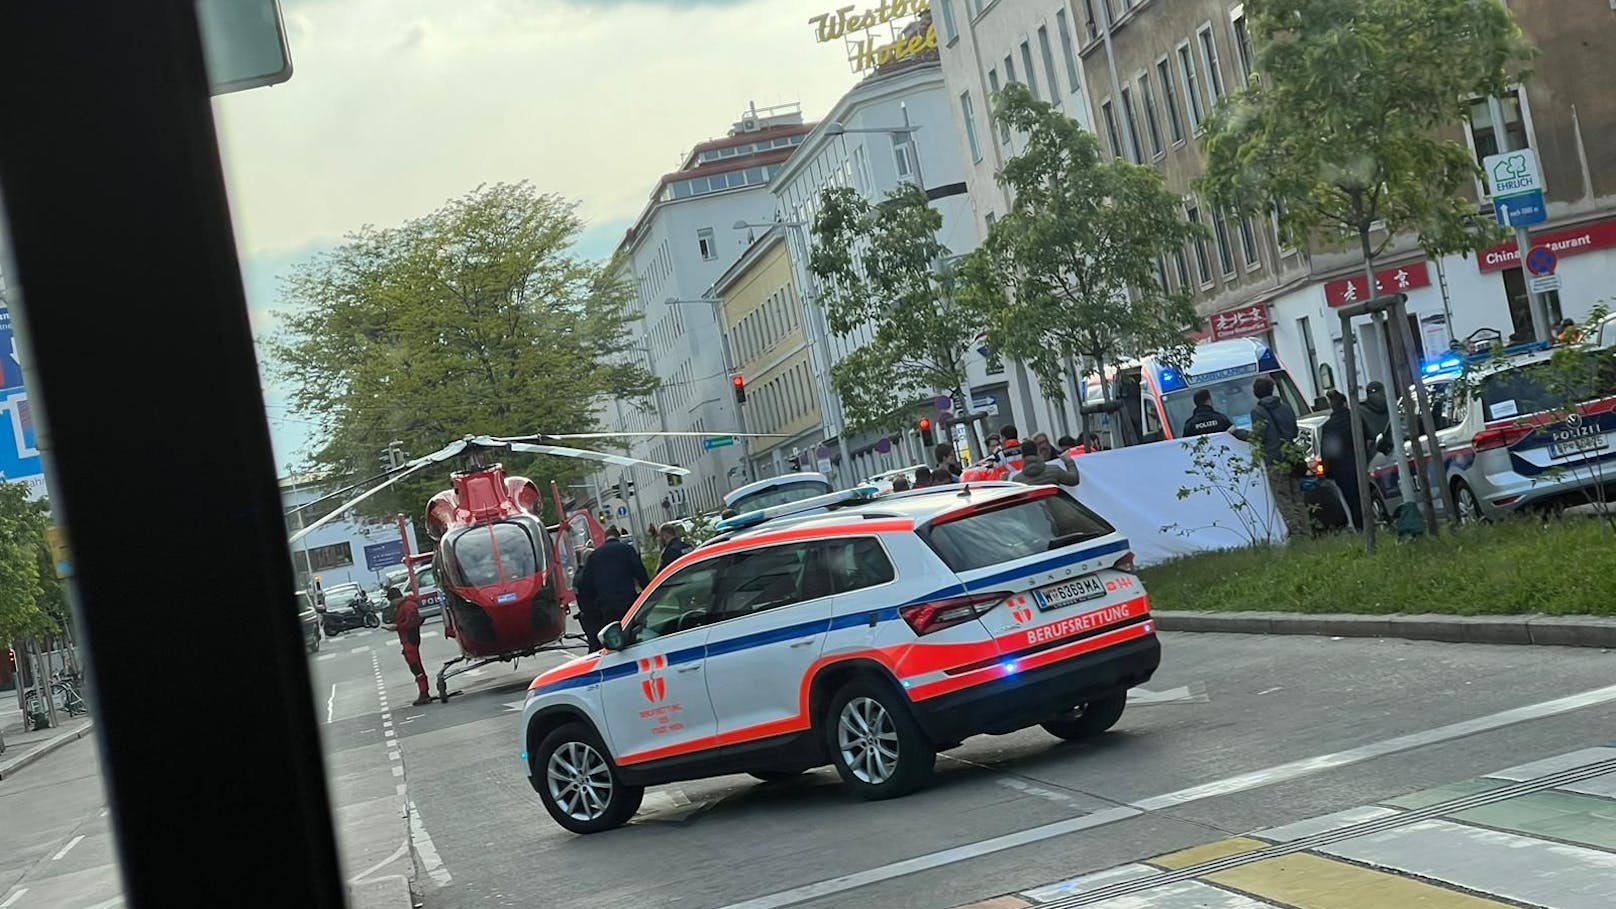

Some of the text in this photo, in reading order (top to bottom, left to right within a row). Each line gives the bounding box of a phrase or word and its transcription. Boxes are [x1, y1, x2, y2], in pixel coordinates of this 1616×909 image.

[854, 24, 937, 73] Hotel
[1496, 177, 1534, 192] EHRLICH
[1486, 249, 1521, 265] China
[1195, 419, 1219, 430] POLIZEI
[1057, 581, 1085, 600] 6369
[1085, 577, 1102, 593] MA
[1027, 604, 1129, 645] BERUFSRETTUNG
